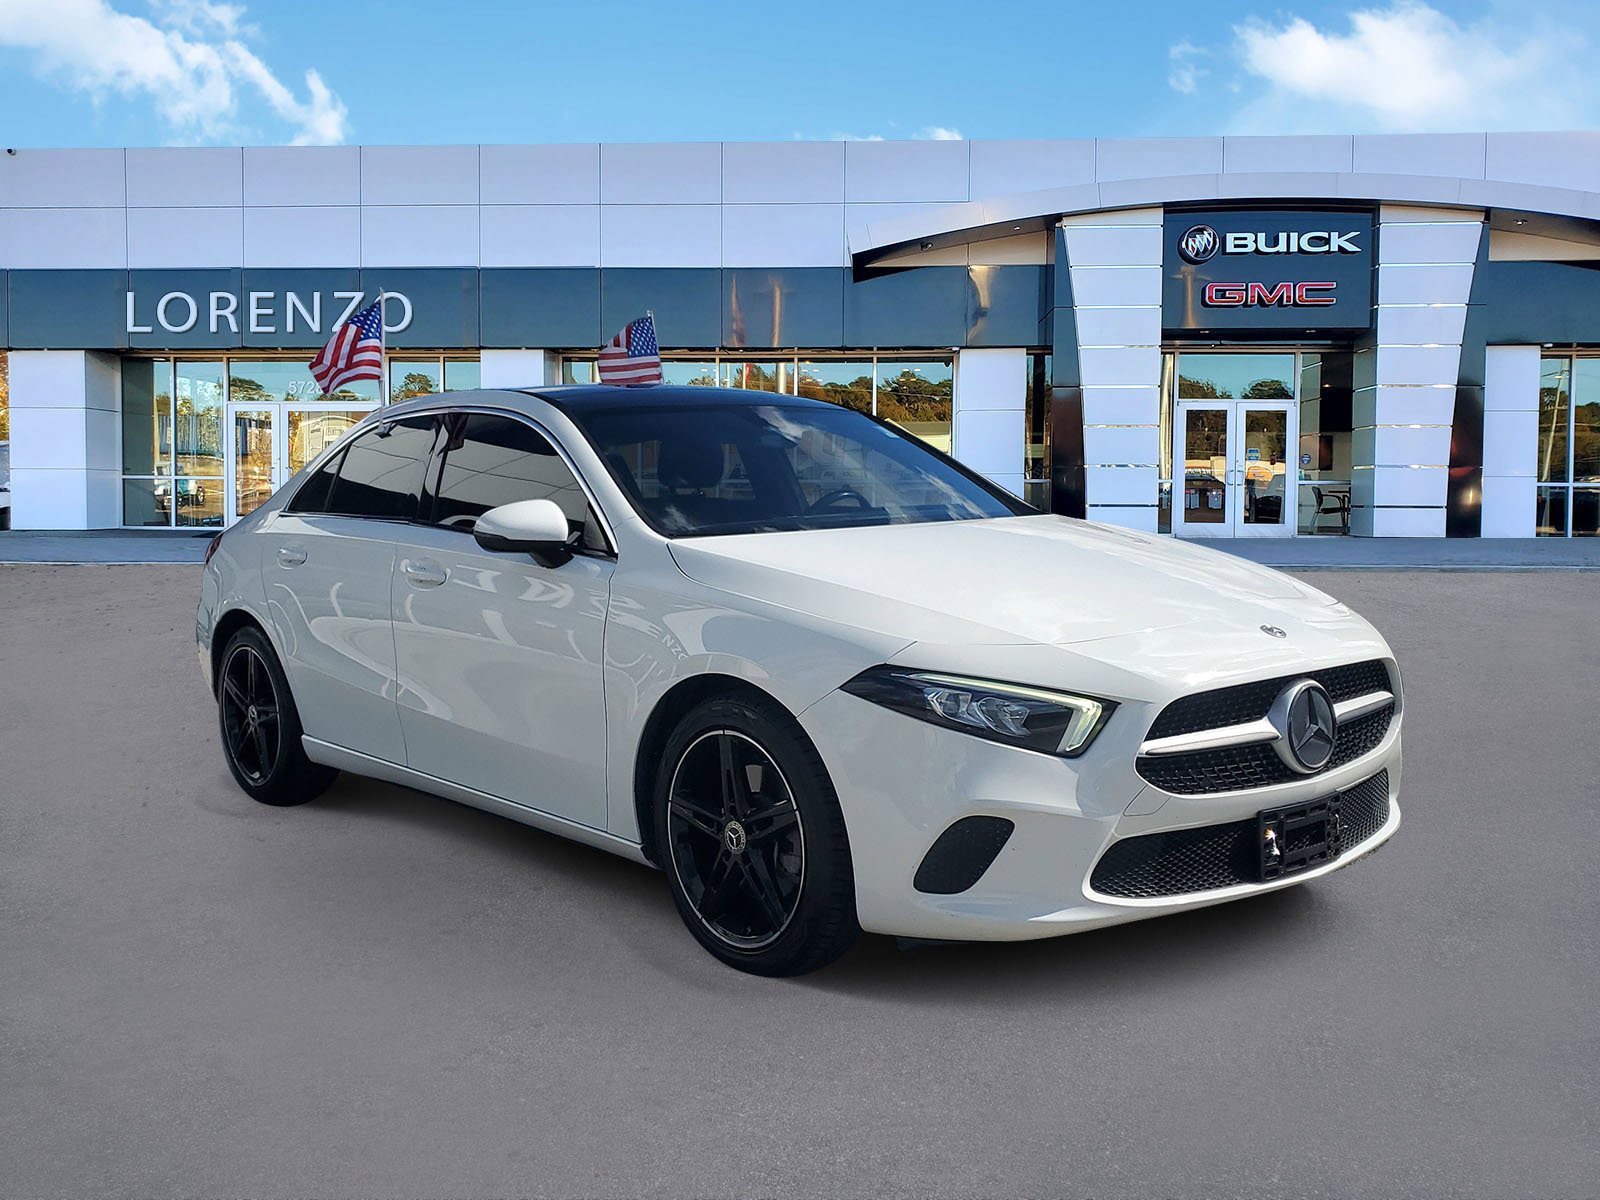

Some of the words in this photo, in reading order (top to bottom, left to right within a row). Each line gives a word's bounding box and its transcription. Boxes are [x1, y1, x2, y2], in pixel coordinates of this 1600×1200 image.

[1225, 231, 1362, 253] BUICK
[1205, 282, 1337, 305] GMC
[126, 291, 413, 333] LORENZO
